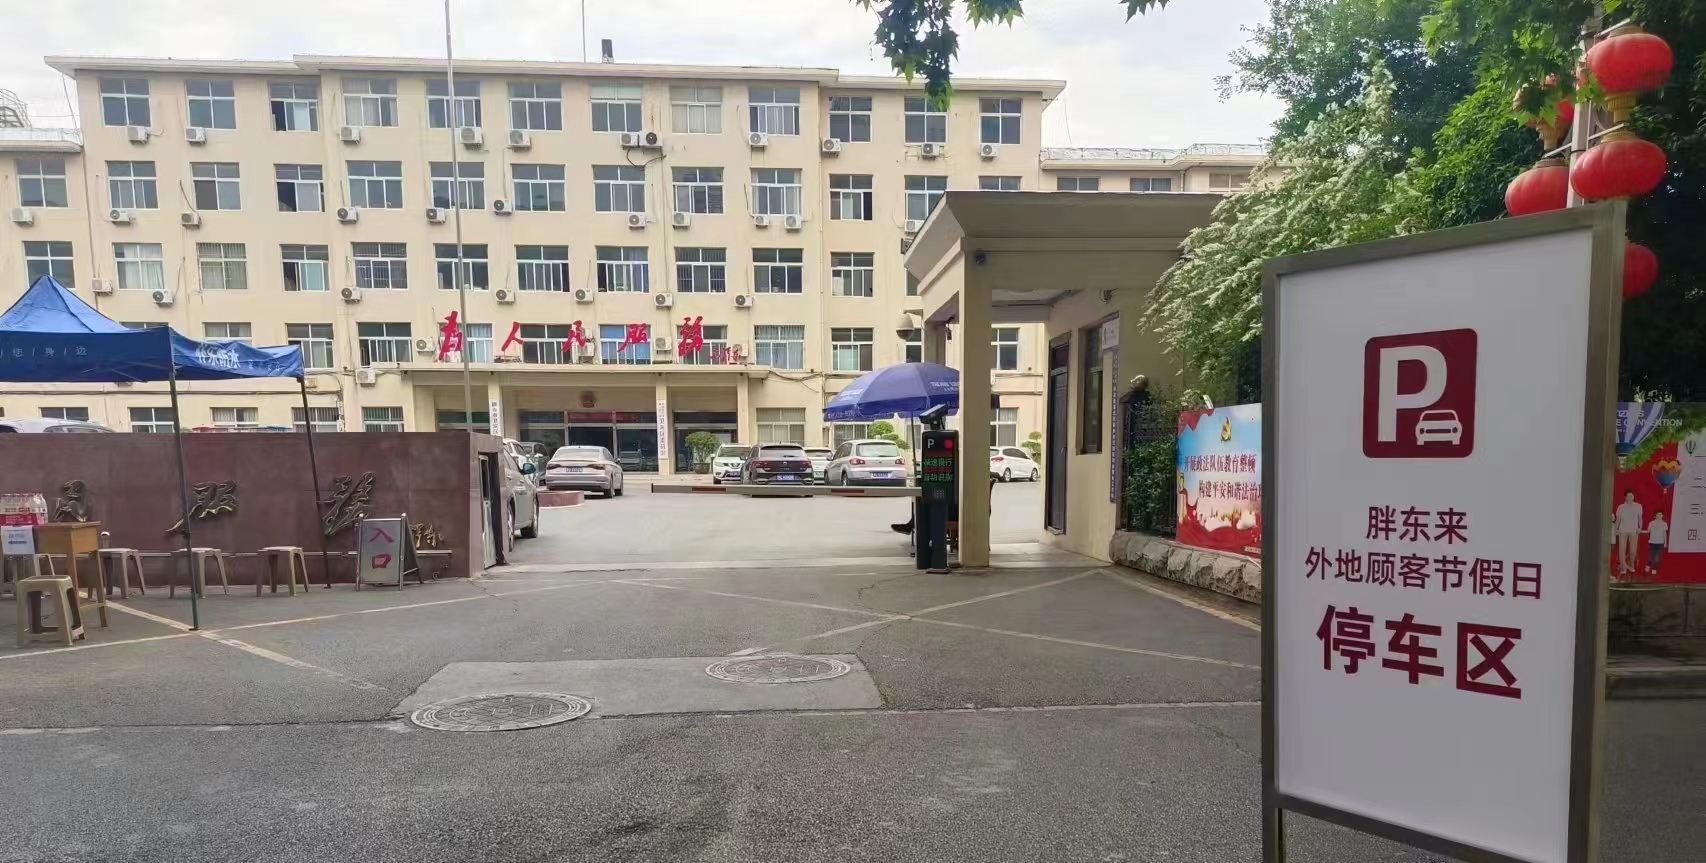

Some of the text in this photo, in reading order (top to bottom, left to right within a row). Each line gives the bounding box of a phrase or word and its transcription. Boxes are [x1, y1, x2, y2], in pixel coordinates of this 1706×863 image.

[1377, 345, 1447, 442] P
[1184, 453, 1257, 474] 开展政法队伍教育整顿
[369, 527, 394, 569] 入口
[1365, 505, 1469, 545] 胖东来
[1304, 546, 1543, 600] 外地顾客节假日
[1316, 603, 1523, 700] 停车区
